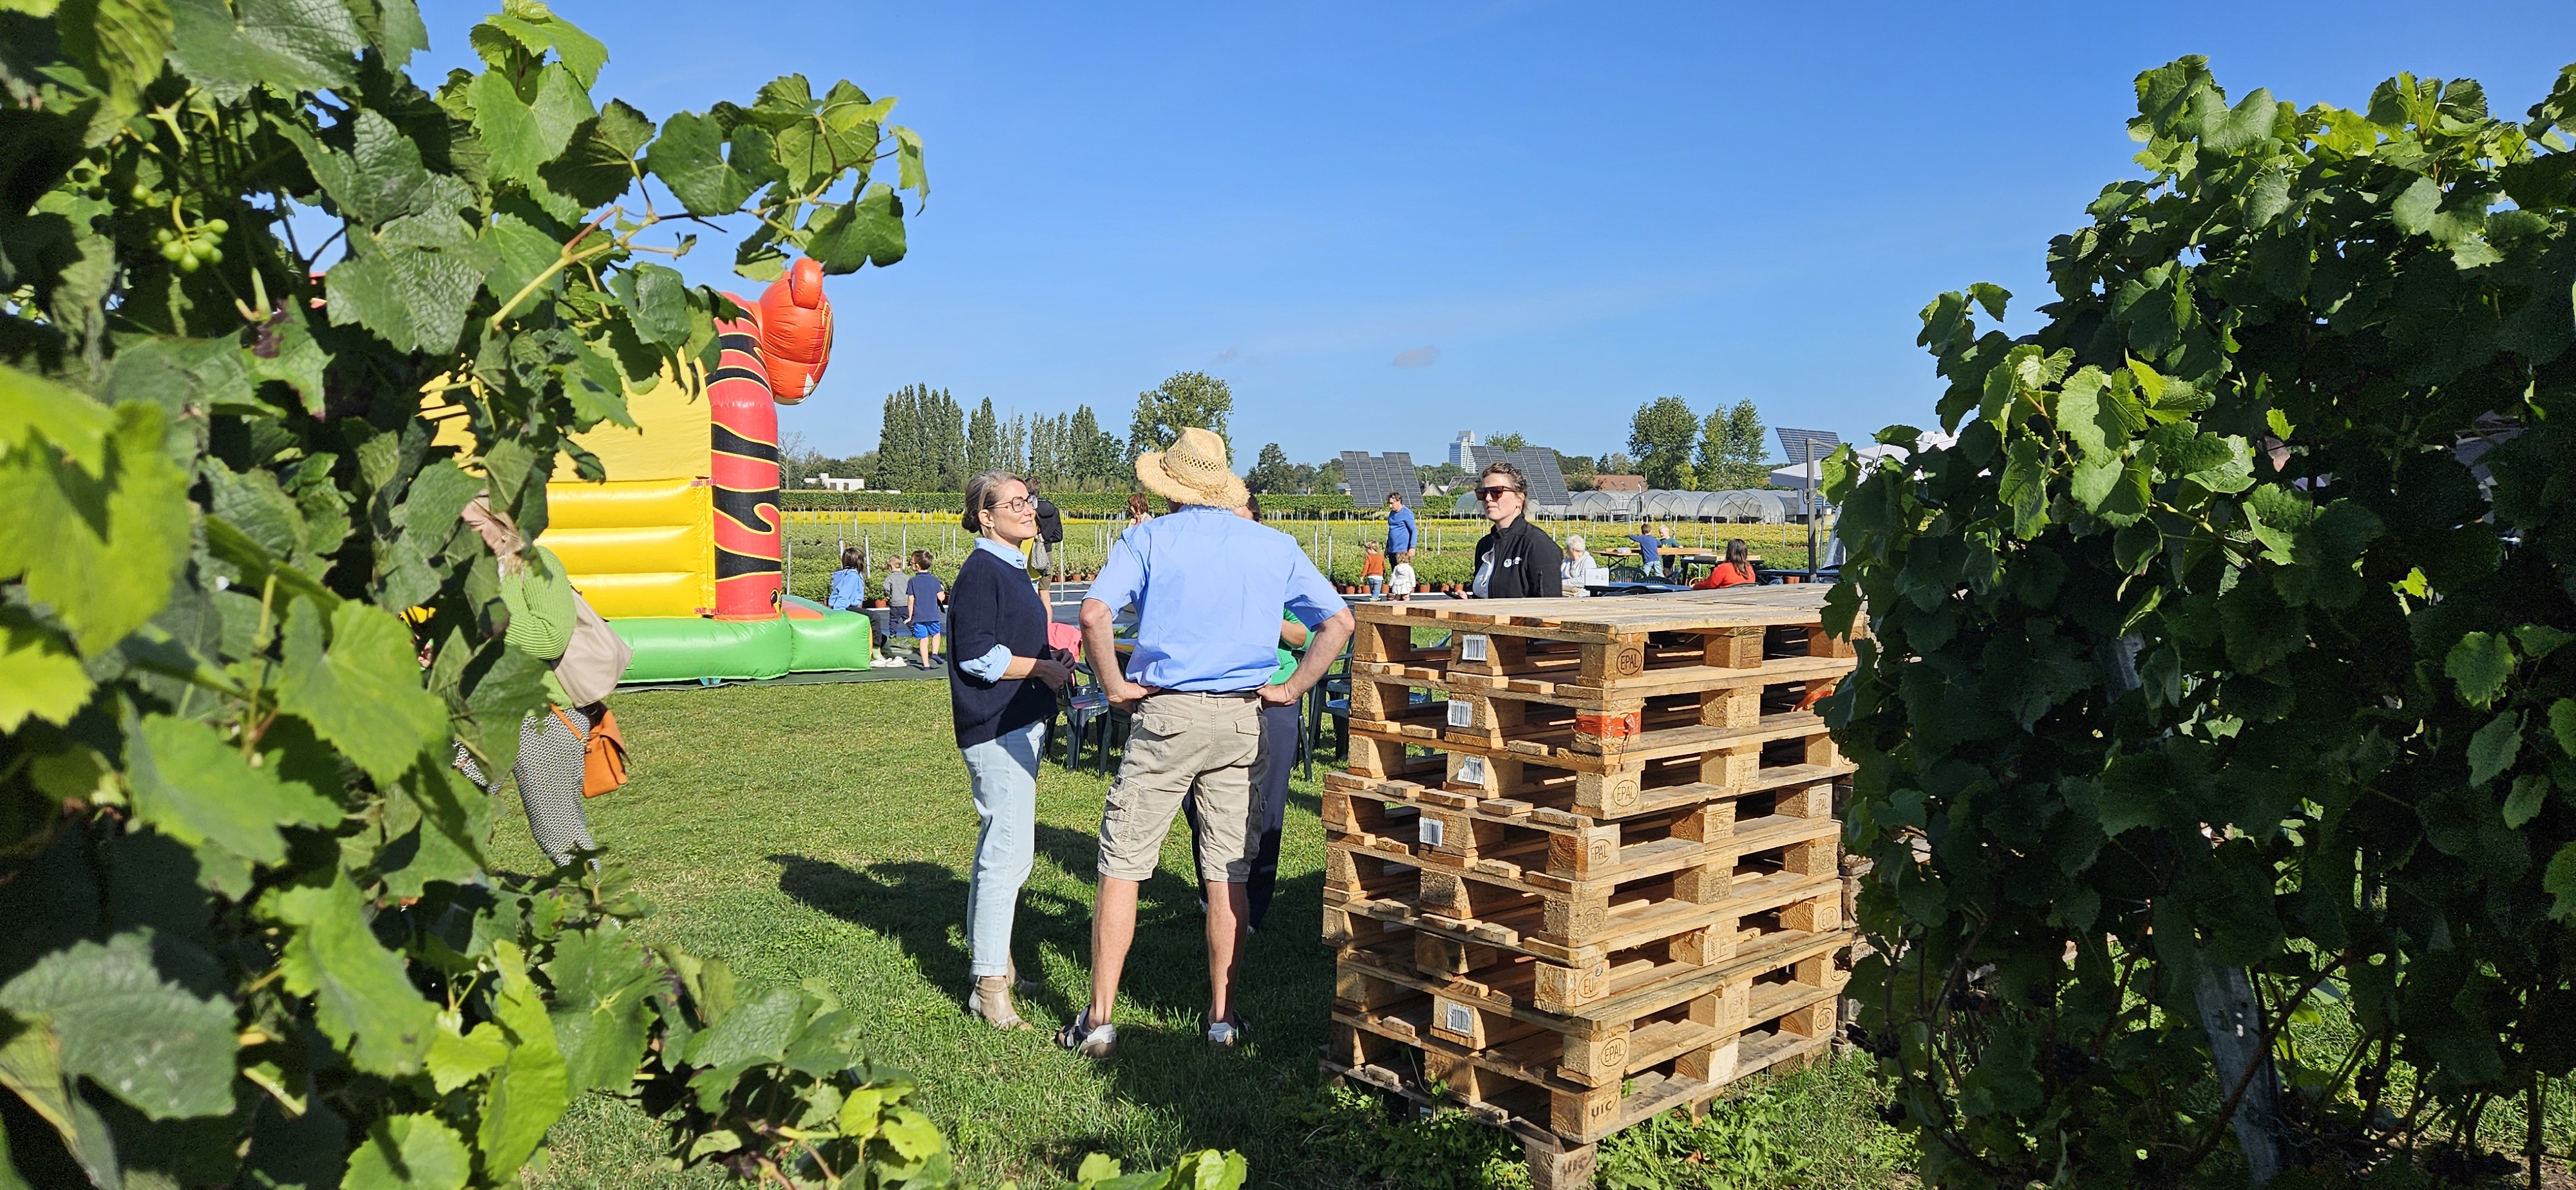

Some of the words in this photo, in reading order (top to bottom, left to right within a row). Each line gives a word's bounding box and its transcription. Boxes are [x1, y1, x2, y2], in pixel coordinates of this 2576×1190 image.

[1620, 654, 1638, 670] EPAL
[1617, 785, 1635, 802] EPAL
[1822, 910, 1833, 927] EUR
[1605, 1043, 1624, 1062] EPAL
